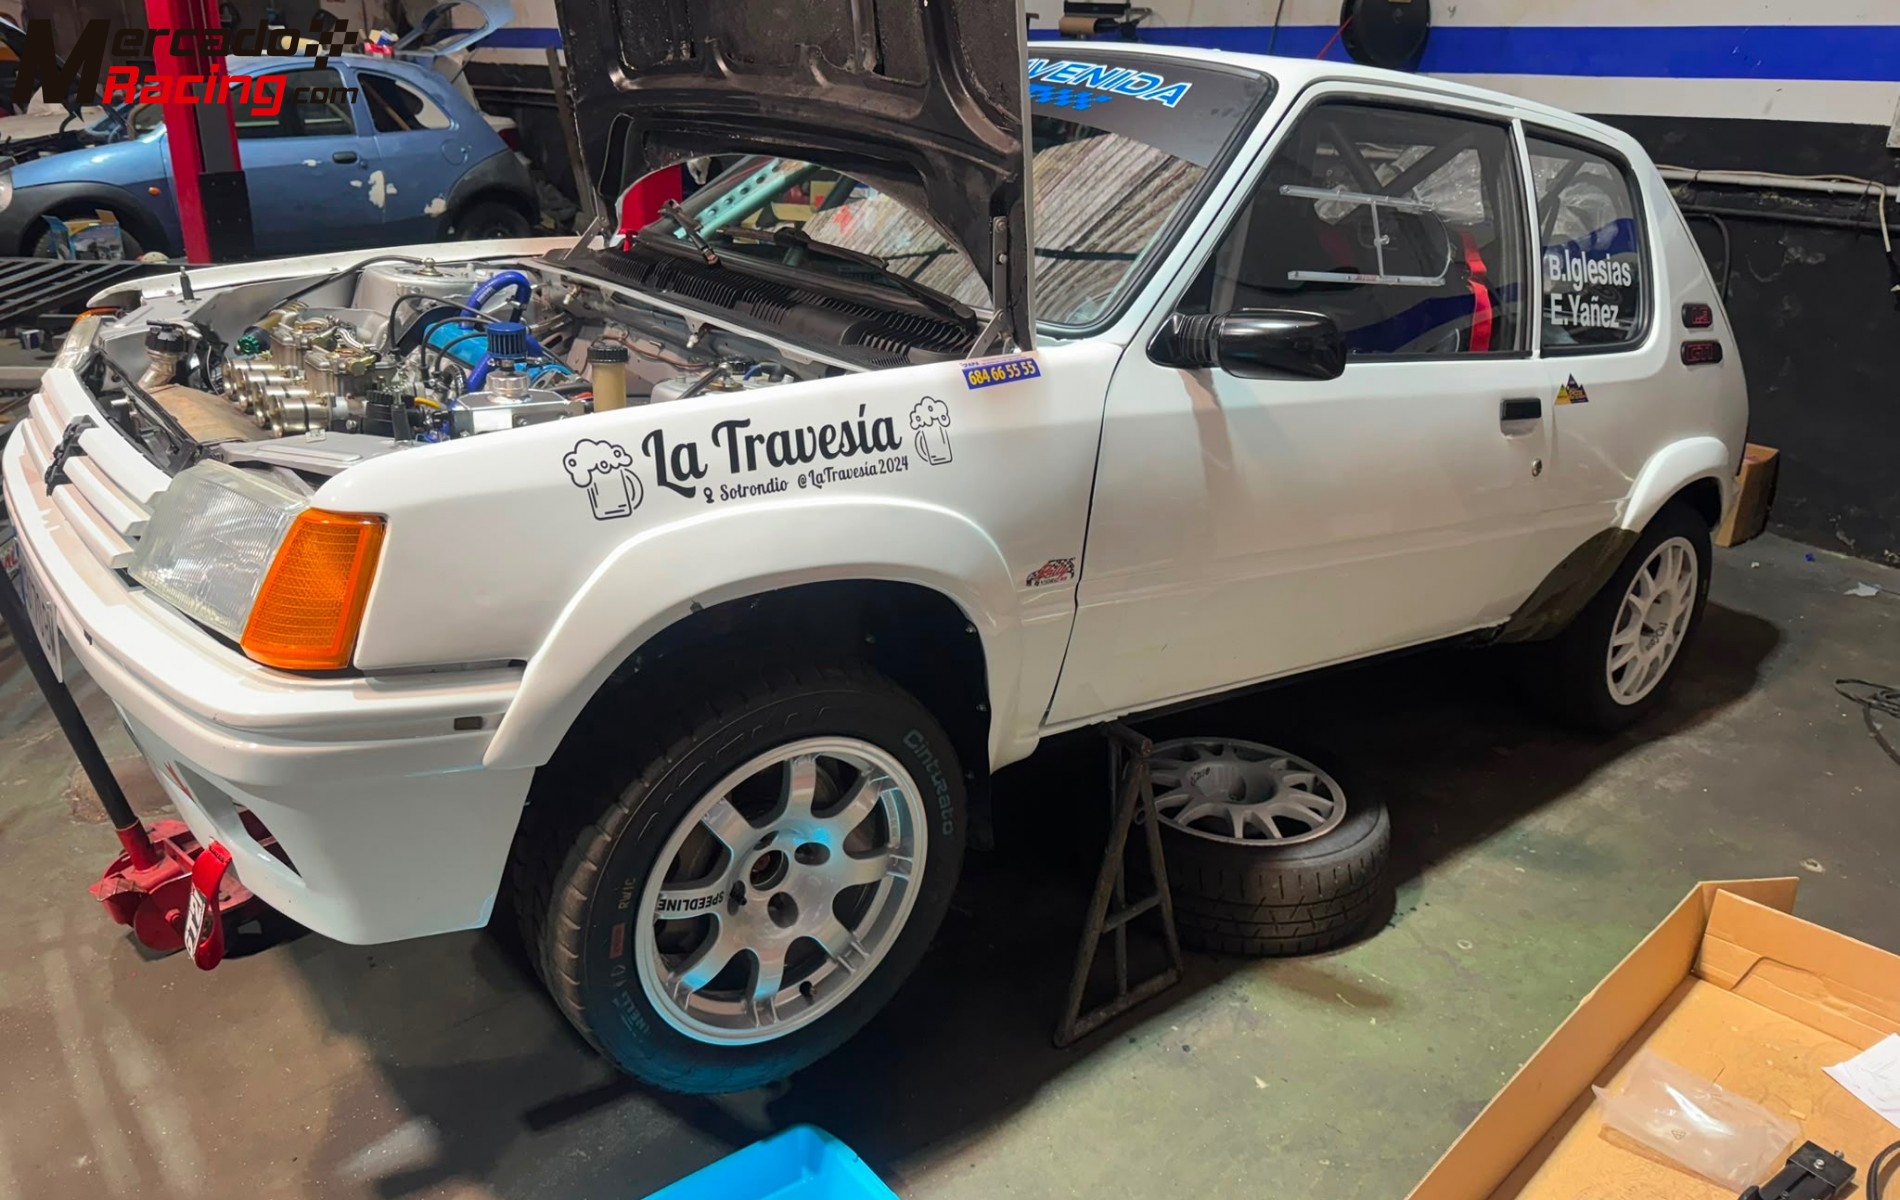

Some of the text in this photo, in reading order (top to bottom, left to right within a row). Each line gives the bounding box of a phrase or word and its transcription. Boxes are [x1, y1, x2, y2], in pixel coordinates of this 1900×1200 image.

[1028, 58, 1192, 108] VENIDA
[1548, 248, 1632, 291] B.Iglesias
[1550, 292, 1620, 328] E.Yañez
[968, 360, 1036, 386] 684 66 55 55
[641, 403, 903, 499] La Travesía
[719, 476, 790, 502] Sotrondio
[657, 890, 724, 912] SPEEDLINE
